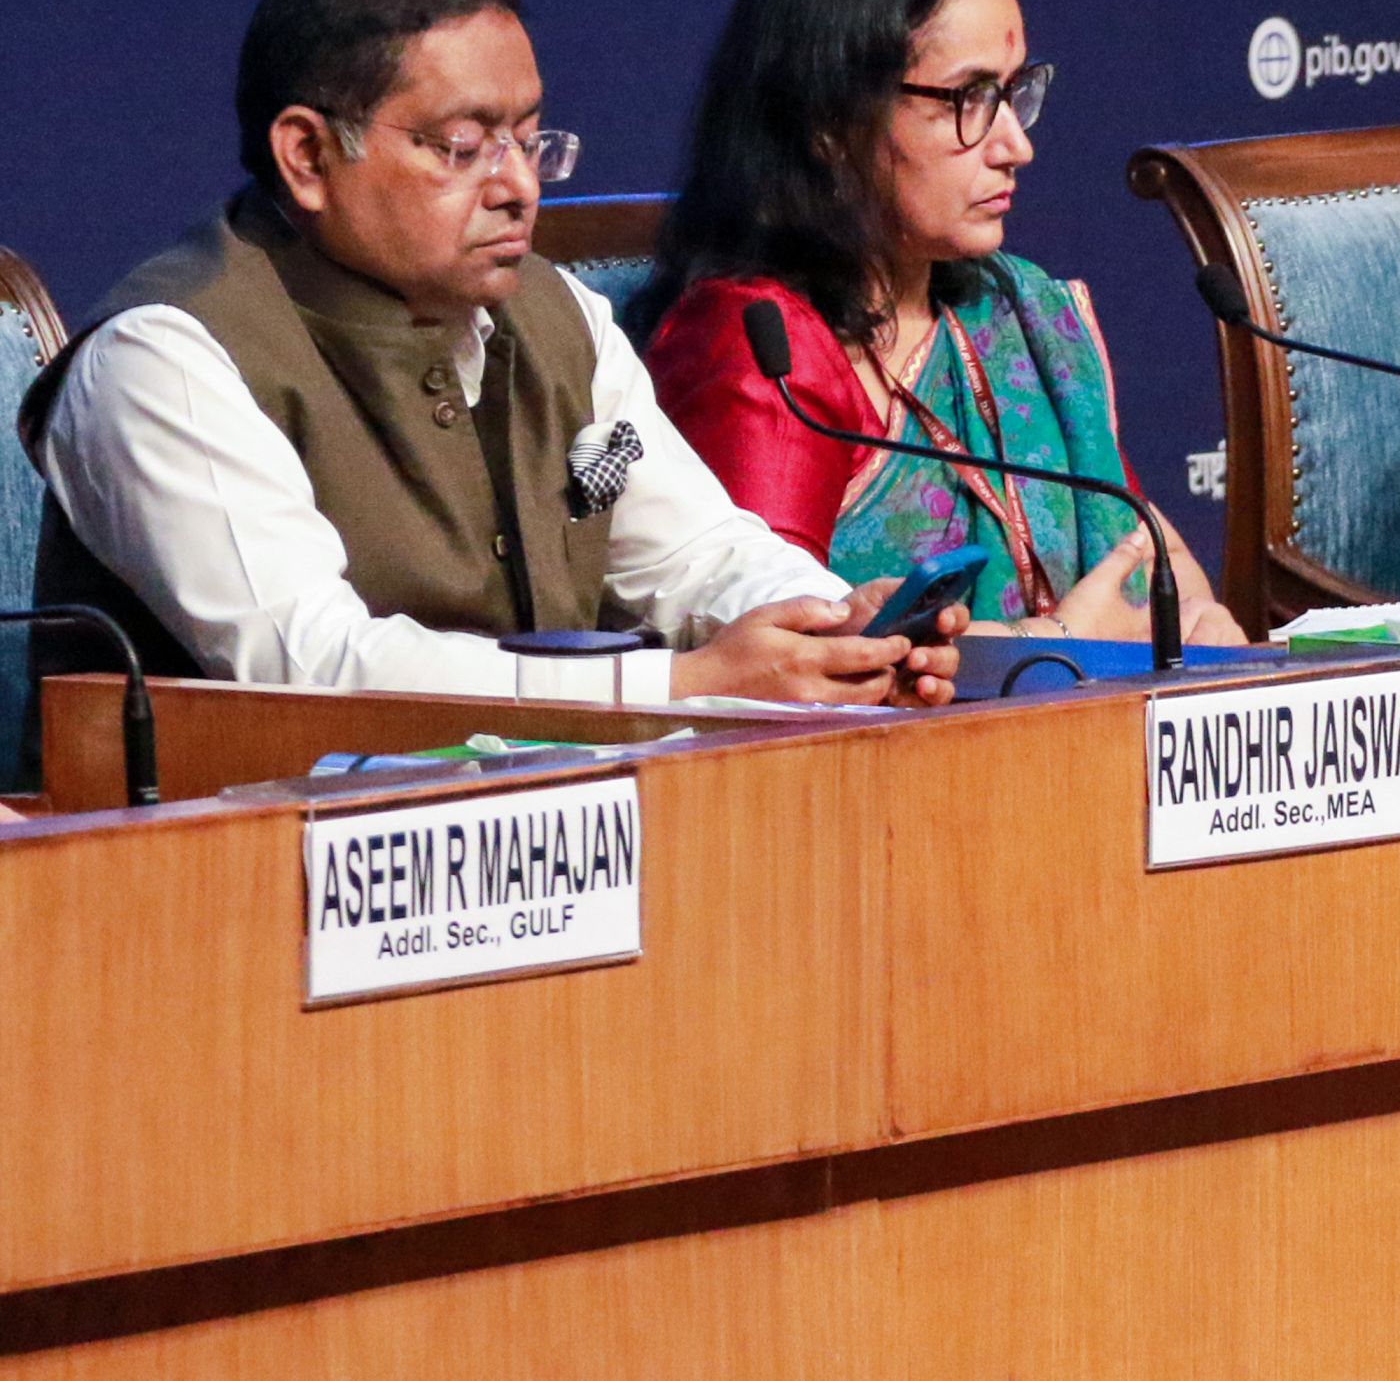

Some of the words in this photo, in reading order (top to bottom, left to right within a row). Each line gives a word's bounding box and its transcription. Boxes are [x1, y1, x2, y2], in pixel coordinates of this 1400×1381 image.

[1157, 705, 1296, 807] RANDHIR
[1209, 803, 1266, 835] Addl.
[320, 827, 434, 931] ASEEM
[446, 824, 468, 912] R
[478, 799, 633, 908] MAHAJAN
[378, 924, 437, 960] Addl.
[447, 922, 501, 949] Sec.,
[510, 903, 575, 939] GULF
